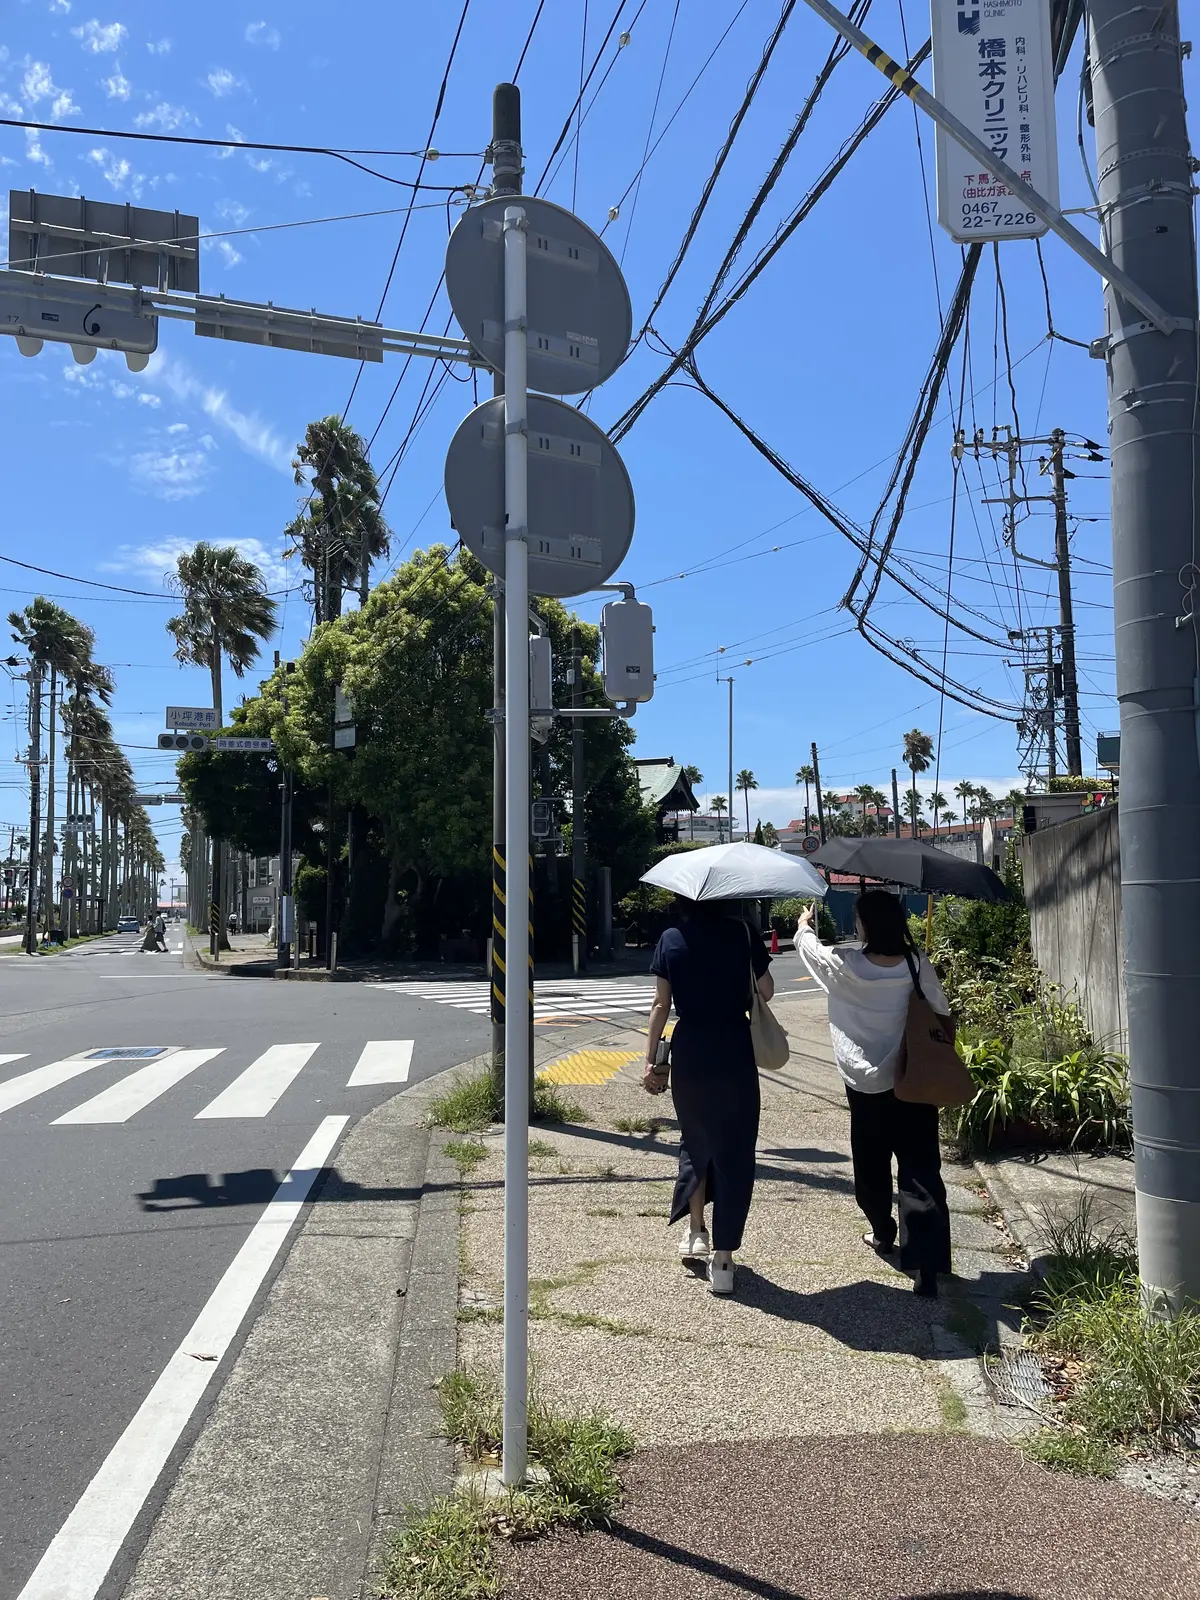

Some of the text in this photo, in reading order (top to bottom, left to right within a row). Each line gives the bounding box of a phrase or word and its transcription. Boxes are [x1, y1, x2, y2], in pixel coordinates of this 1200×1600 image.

[983, 0, 1022, 8] HASHIMOTO
[983, 9, 1006, 18] CLINIC
[977, 37, 1008, 161] 橋本クリニック
[961, 201, 998, 215] 0467
[962, 212, 1036, 228] 22-7226
[170, 710, 216, 721] 小坪港前
[806, 840, 816, 849] 30
